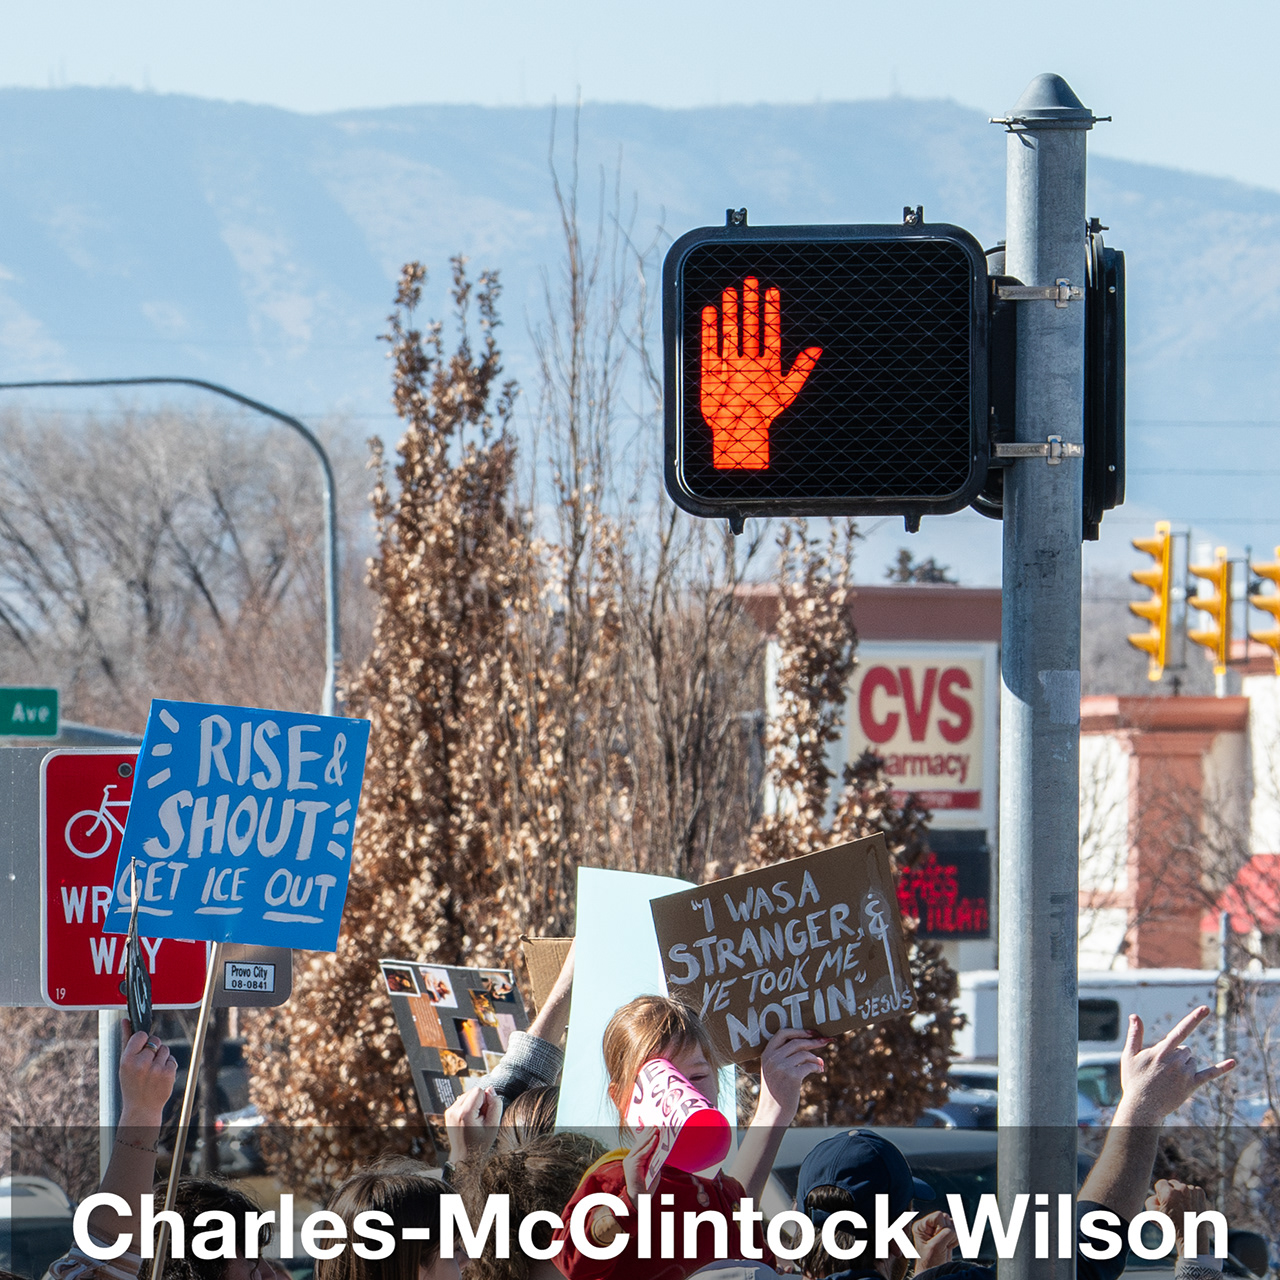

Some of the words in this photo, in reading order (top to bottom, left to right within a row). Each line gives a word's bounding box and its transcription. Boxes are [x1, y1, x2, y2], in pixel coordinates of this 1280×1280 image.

[11, 701, 51, 723] Ave
[858, 665, 974, 744] CVS
[196, 713, 322, 790] RISE
[142, 790, 333, 861] SHOUT
[117, 860, 189, 902] GET
[201, 867, 251, 905] ICE
[264, 869, 337, 911] OUT
[724, 881, 796, 923] WAS
[798, 869, 821, 908] A
[90, 937, 165, 974] WY
[231, 964, 251, 978] Provo
[253, 965, 268, 980] City
[742, 955, 810, 1003] TOOK
[55, 987, 67, 1000] 19
[231, 979, 267, 990] 08-0841
